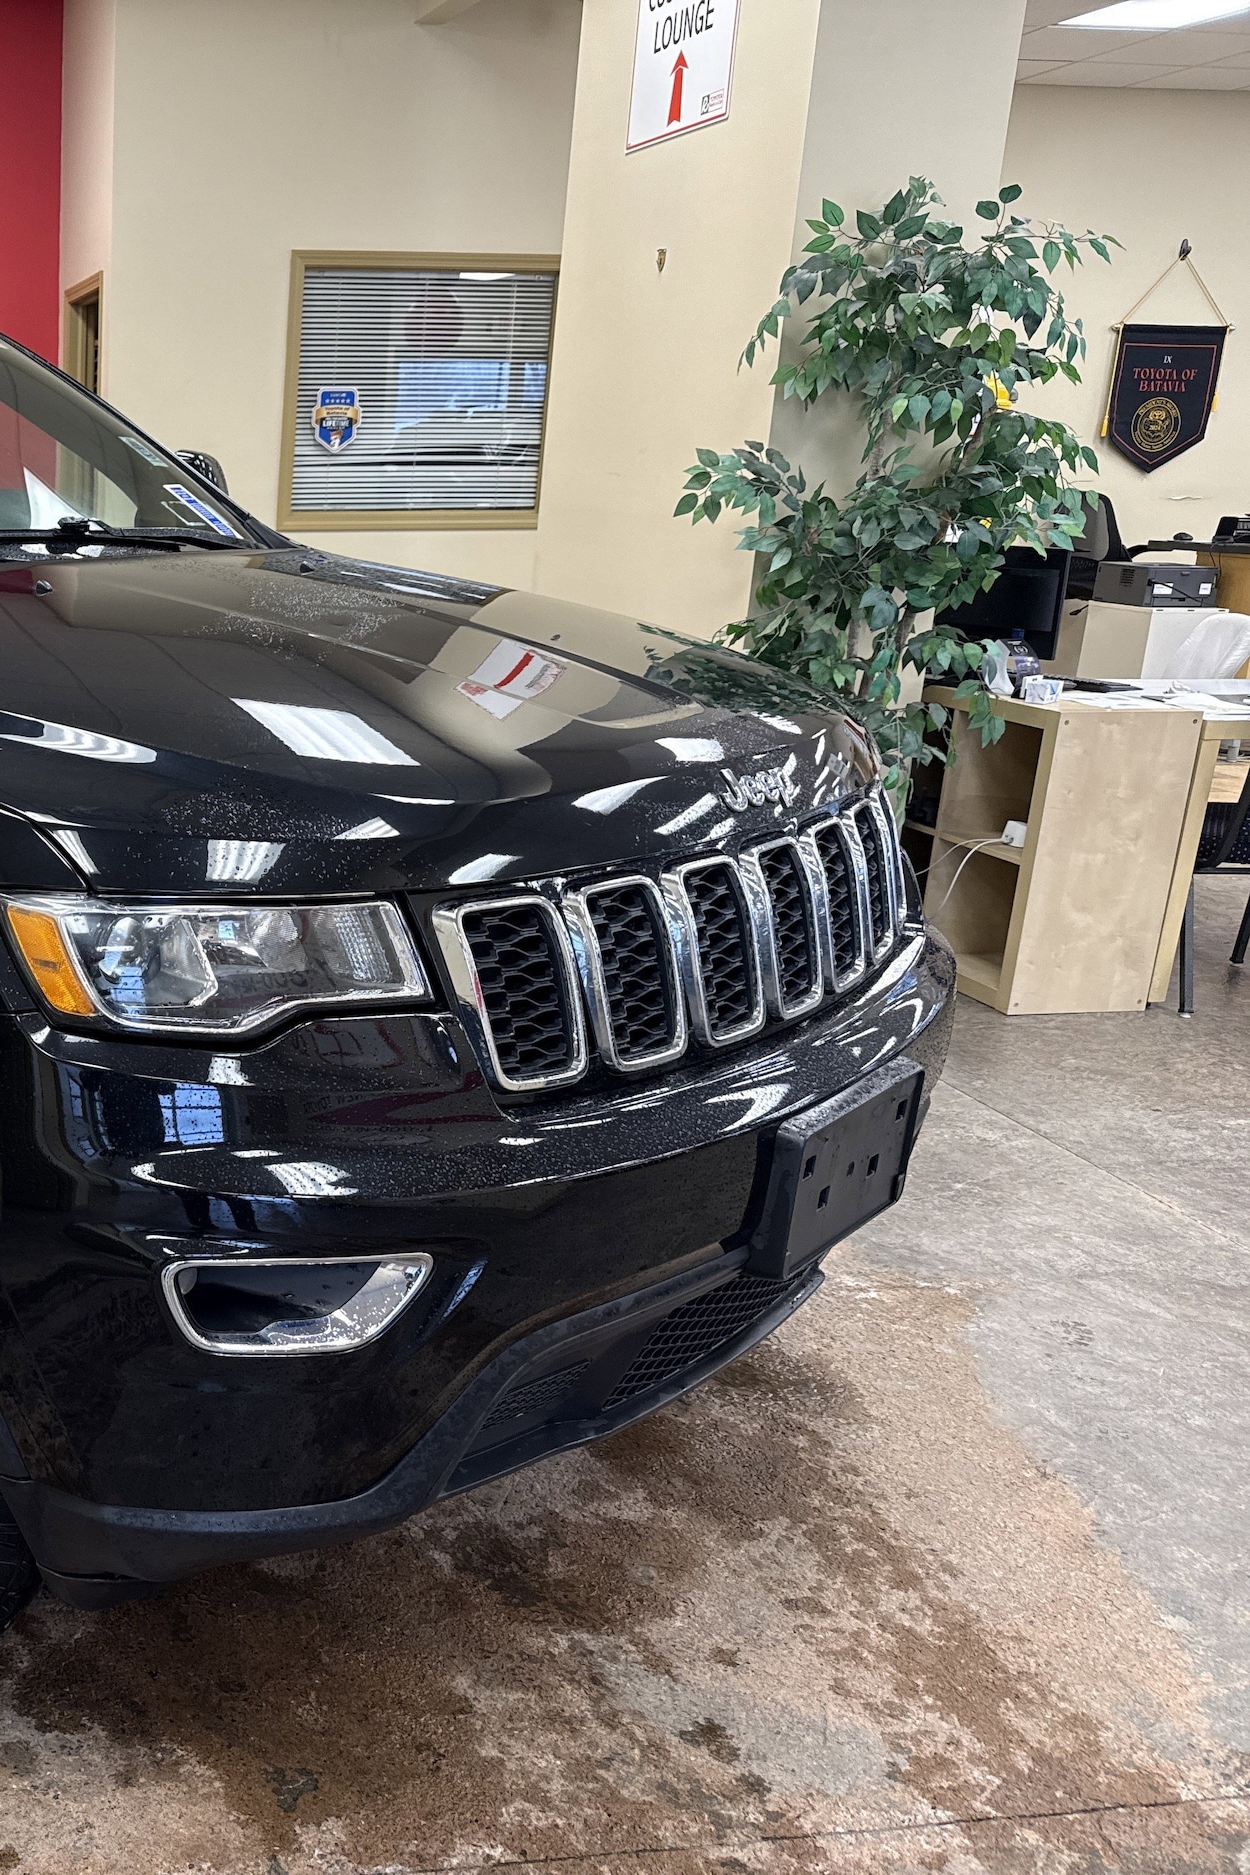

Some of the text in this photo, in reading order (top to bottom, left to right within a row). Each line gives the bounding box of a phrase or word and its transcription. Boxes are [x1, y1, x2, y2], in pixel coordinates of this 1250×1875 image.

[654, 0, 714, 54] LOUNGE
[1163, 355, 1172, 364] IX
[1133, 368, 1197, 380] TOYOTA OF
[1139, 380, 1186, 392] BATAVIA
[322, 419, 350, 427] LIFETIME
[719, 768, 795, 813] Jeep
